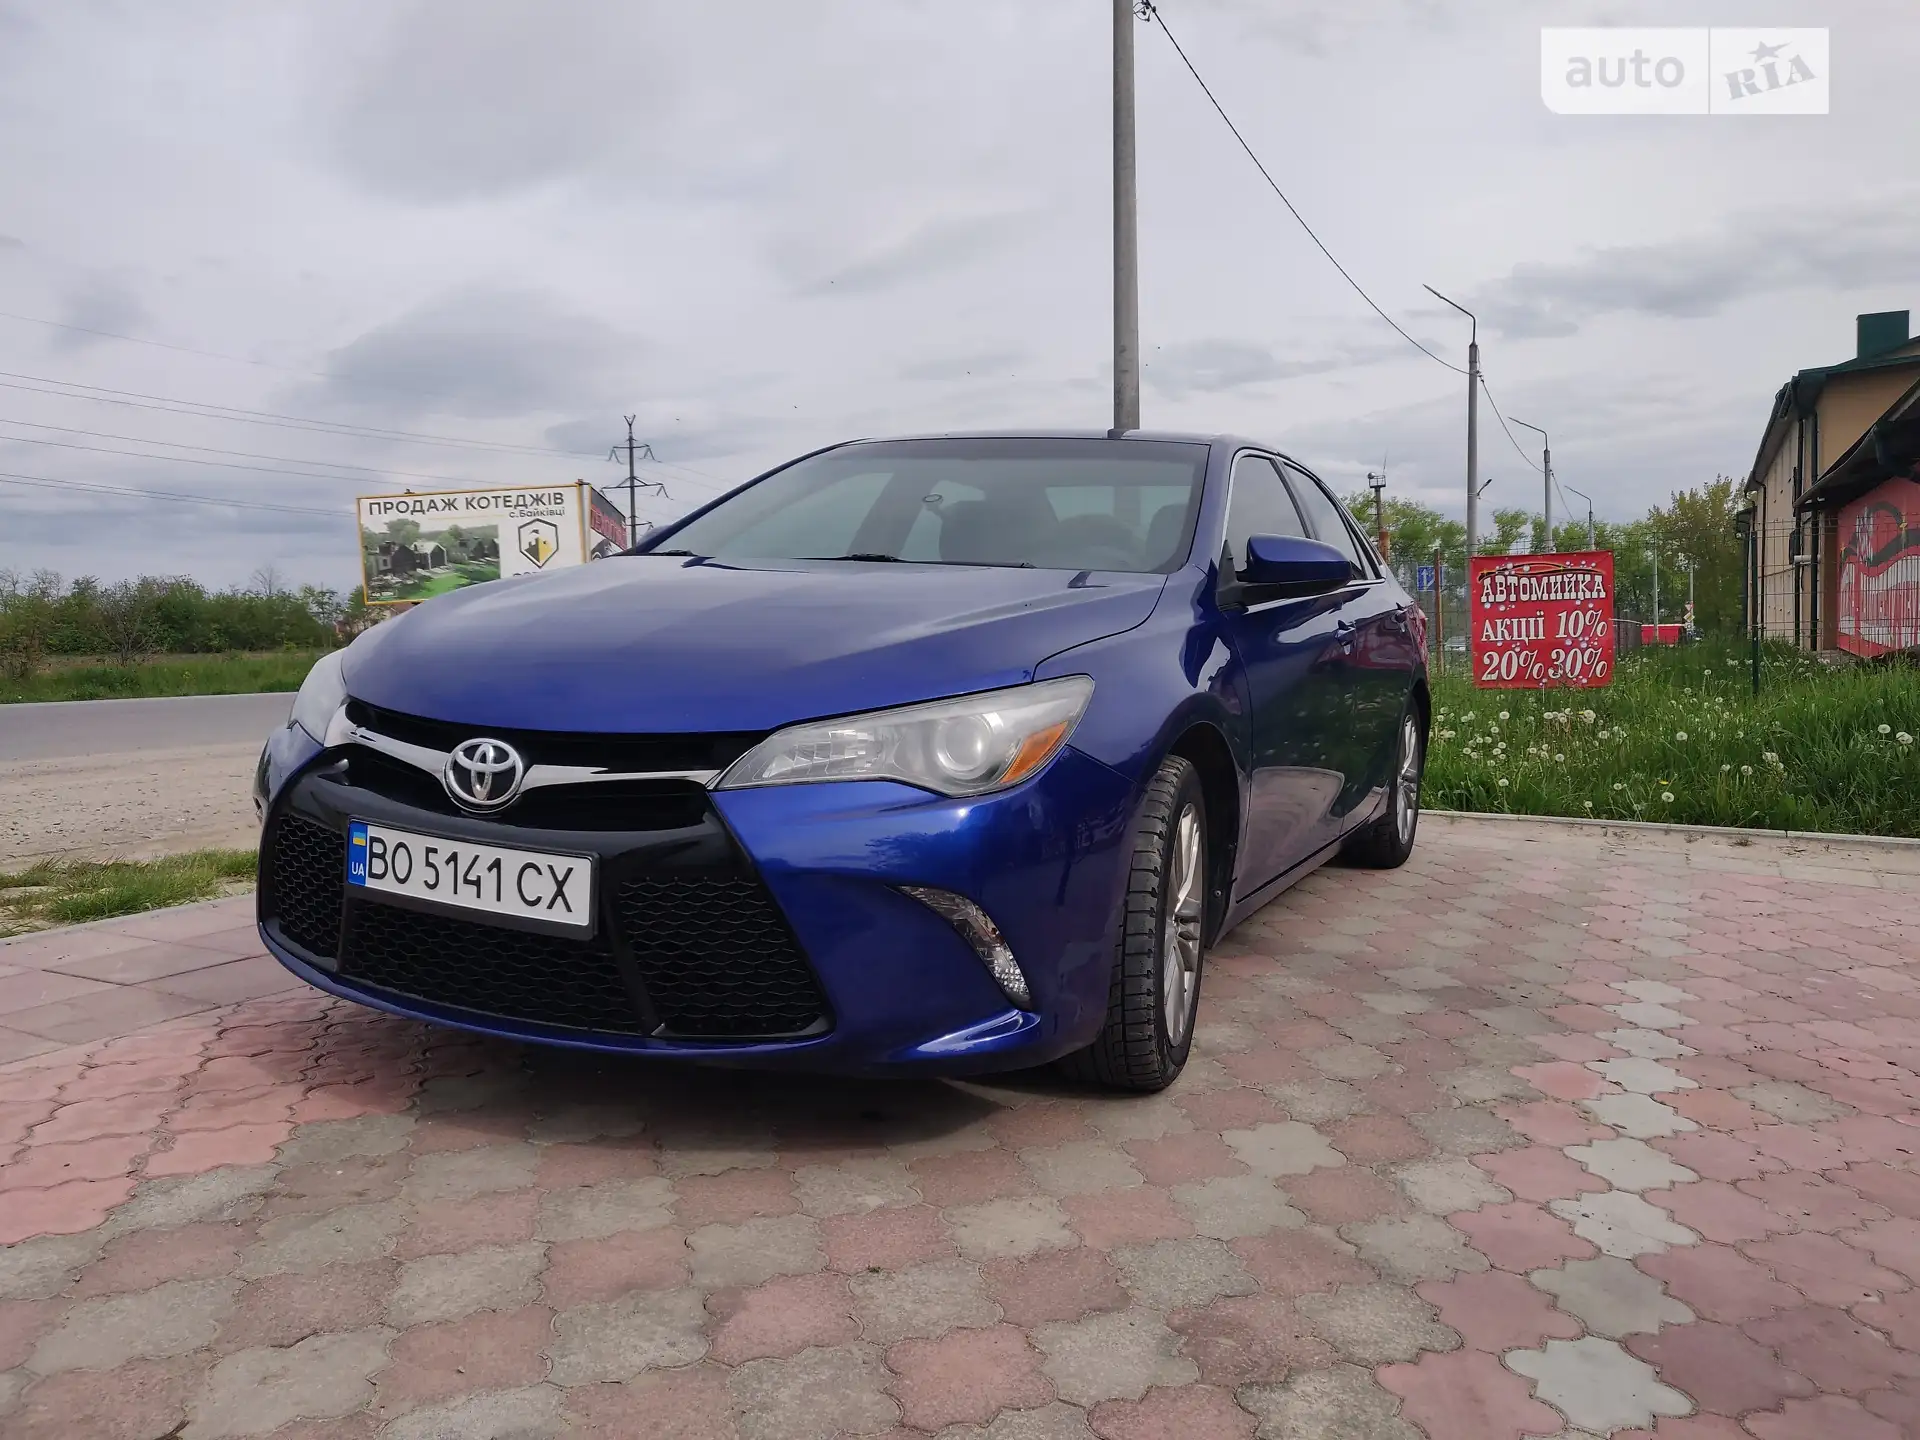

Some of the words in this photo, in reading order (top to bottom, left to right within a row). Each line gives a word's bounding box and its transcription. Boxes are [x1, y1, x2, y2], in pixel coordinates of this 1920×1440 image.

[369, 497, 458, 516] ПРОДАЖ
[465, 492, 565, 509] КОТЕДЖІВ
[1481, 573, 1606, 602] АВТОМИЙКА
[1481, 610, 1545, 645] АКЦІЇ
[1555, 609, 1608, 638] 10%
[1481, 650, 1545, 681] 20%
[1548, 647, 1608, 679] 30%
[351, 862, 365, 877] UA
[368, 836, 413, 884] BO
[424, 846, 502, 902] 5141
[517, 862, 574, 913] CX
